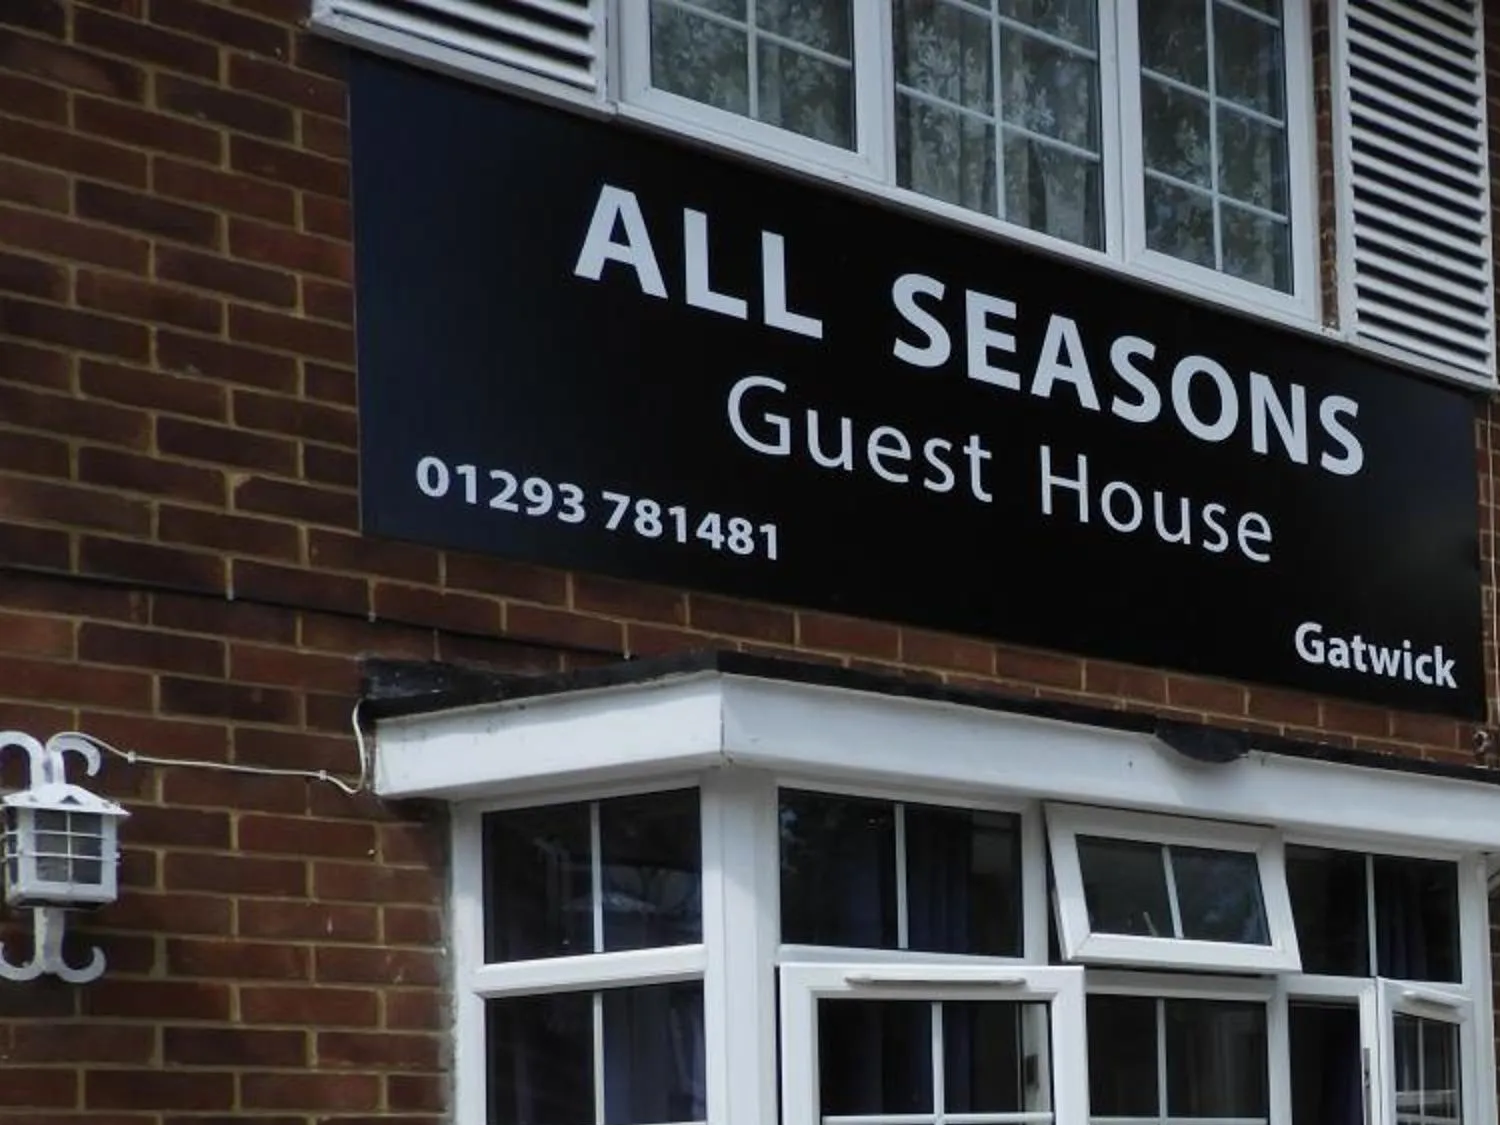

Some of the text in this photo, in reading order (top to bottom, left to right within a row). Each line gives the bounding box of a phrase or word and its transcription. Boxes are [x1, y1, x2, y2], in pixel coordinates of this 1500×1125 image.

[574, 183, 1365, 476] ALL SEASONS
[416, 456, 778, 561] 01293 781481
[727, 375, 1272, 563] Guest House
[1294, 621, 1458, 689] Gatwick
